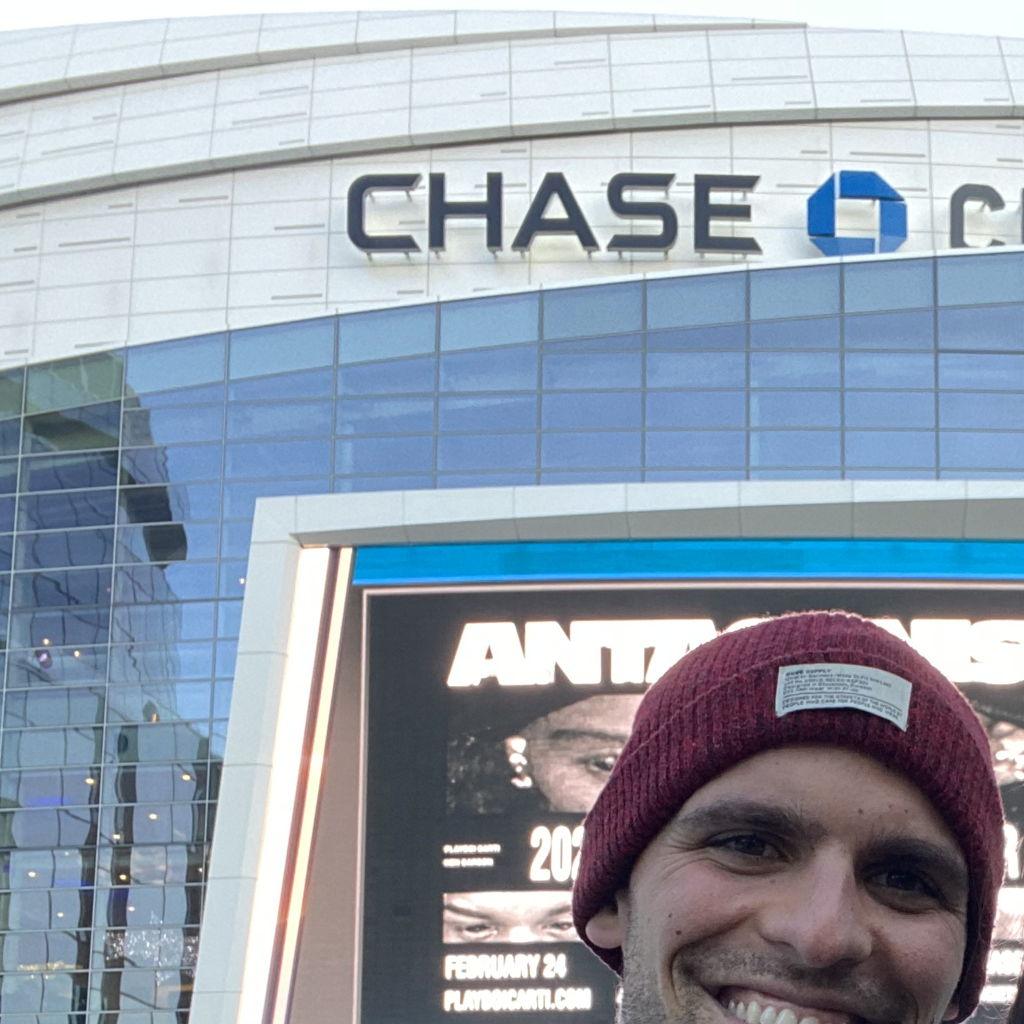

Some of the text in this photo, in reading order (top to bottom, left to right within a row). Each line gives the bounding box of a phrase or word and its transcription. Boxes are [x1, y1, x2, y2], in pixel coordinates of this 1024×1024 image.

[347, 172, 763, 254] CHASE
[444, 952, 567, 980] FEBRUARY 24
